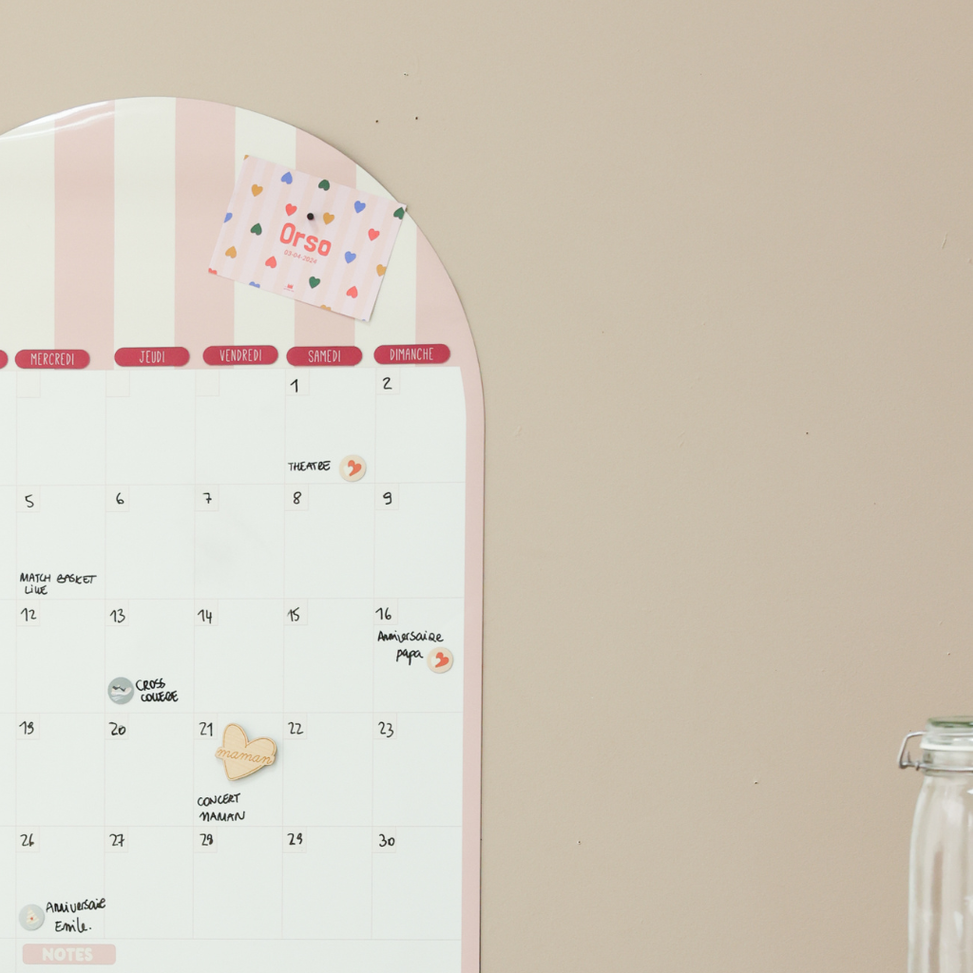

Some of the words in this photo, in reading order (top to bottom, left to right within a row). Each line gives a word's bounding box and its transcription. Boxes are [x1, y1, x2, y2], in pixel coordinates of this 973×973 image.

[279, 222, 332, 257] Orso
[283, 249, 318, 264] 03-04-2024
[29, 352, 75, 367] MERCREDI
[138, 350, 166, 364] JEUDI
[219, 348, 263, 363] VENDREDI
[307, 349, 342, 363] SAMEDI
[389, 346, 435, 361] DIMANCHE
[289, 378, 300, 393] 1
[382, 376, 393, 390] 2
[287, 460, 331, 472] THEATRE
[24, 493, 35, 509] 5
[115, 492, 125, 505] 6
[202, 491, 213, 505] 7
[292, 491, 303, 505] 8
[382, 491, 393, 506] 9
[19, 572, 52, 583] MATCH
[56, 573, 98, 585] BASKET
[20, 607, 37, 622] 12
[109, 608, 126, 624] 13
[197, 608, 214, 624] 14
[287, 606, 300, 622] 15
[374, 607, 392, 621] 16
[395, 648, 424, 666] papa
[135, 677, 166, 692] CROSS
[140, 689, 179, 703] COLLEGE
[19, 720, 35, 735] 19
[108, 721, 127, 736] 20
[199, 721, 213, 737] 21
[287, 721, 304, 735] 22
[378, 721, 394, 739] 23
[216, 748, 273, 765] maman
[197, 792, 241, 807] CONCERT
[198, 810, 246, 823] MAMAN
[20, 833, 35, 848] 26
[109, 833, 125, 847] 27
[199, 833, 214, 847] 28
[287, 832, 303, 846] 29
[378, 833, 396, 848] 30
[42, 947, 94, 962] NOTES
